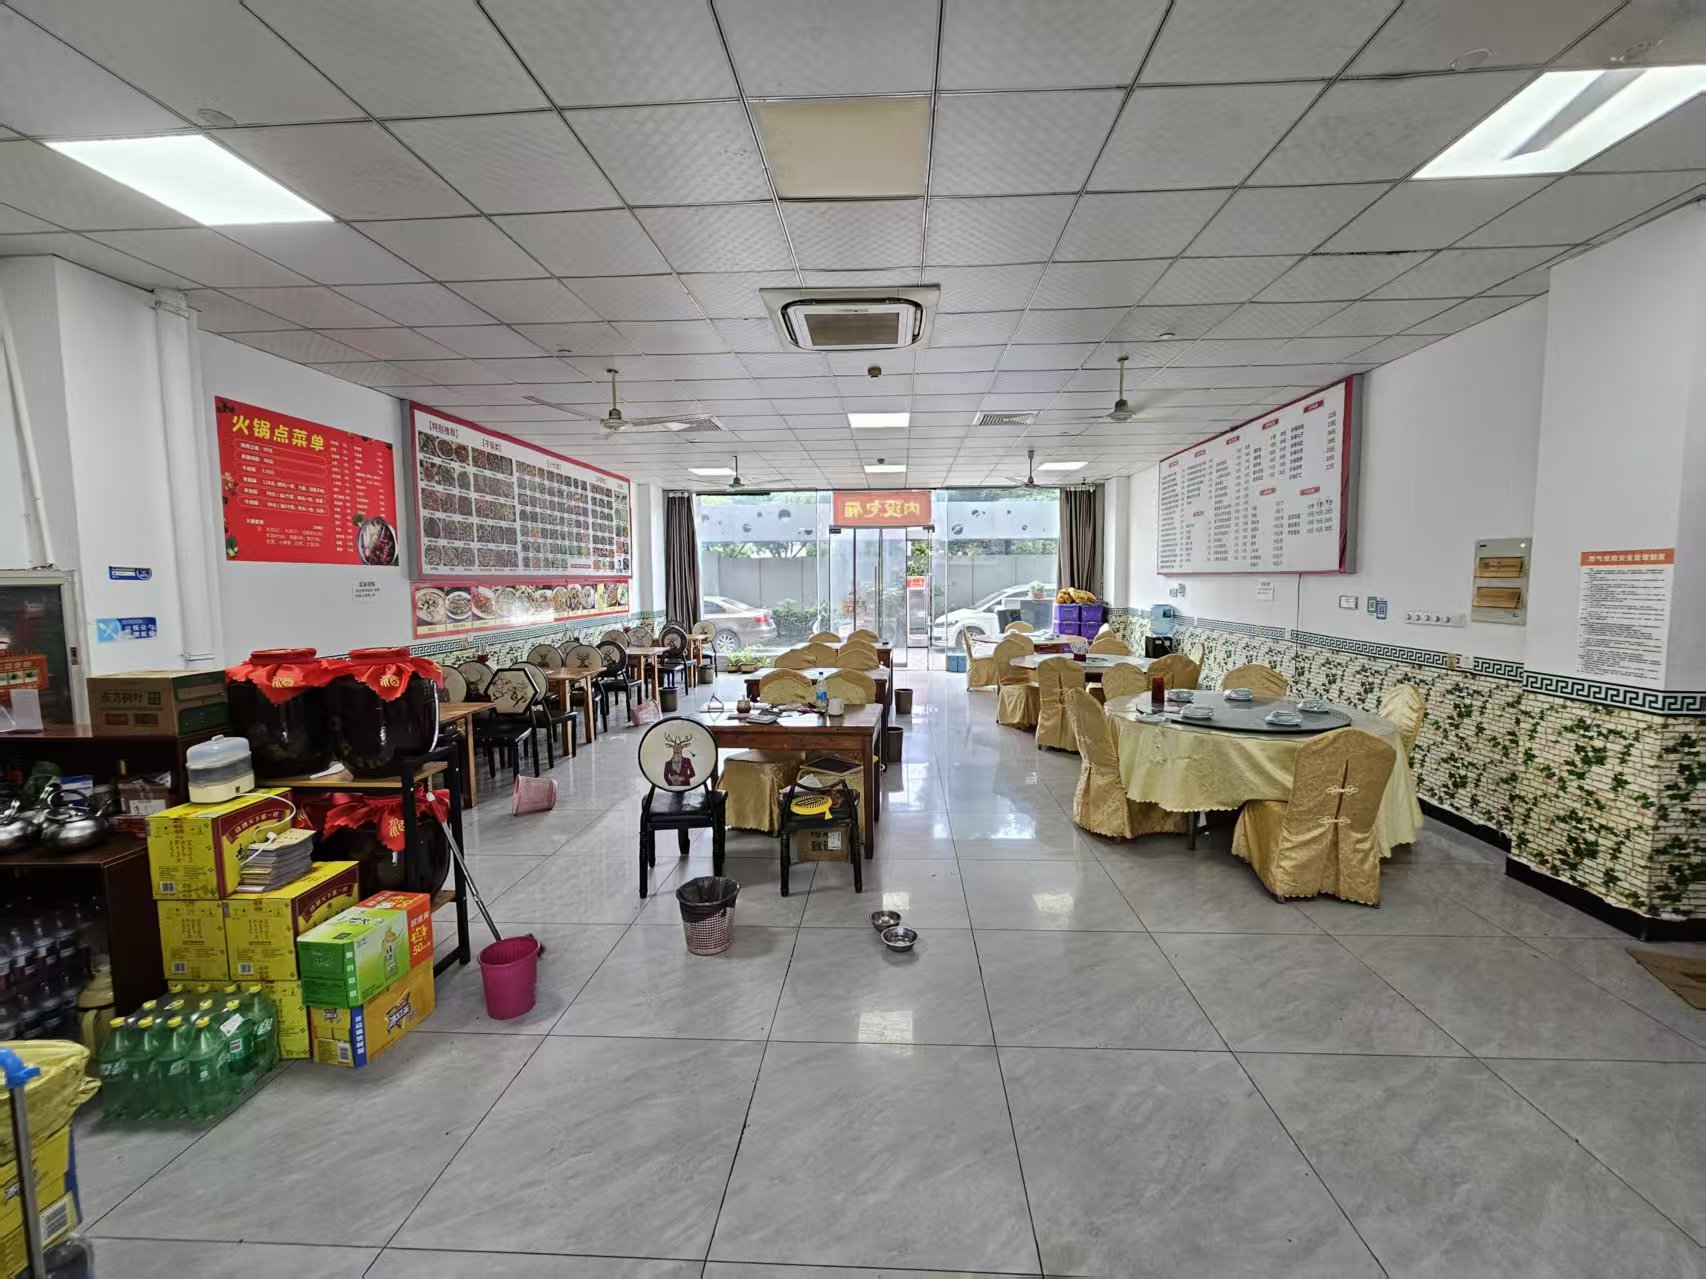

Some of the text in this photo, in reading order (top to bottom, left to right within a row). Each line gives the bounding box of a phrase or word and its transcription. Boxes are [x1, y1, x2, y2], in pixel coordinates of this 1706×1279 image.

[232, 415, 325, 452] 火锅点菜单
